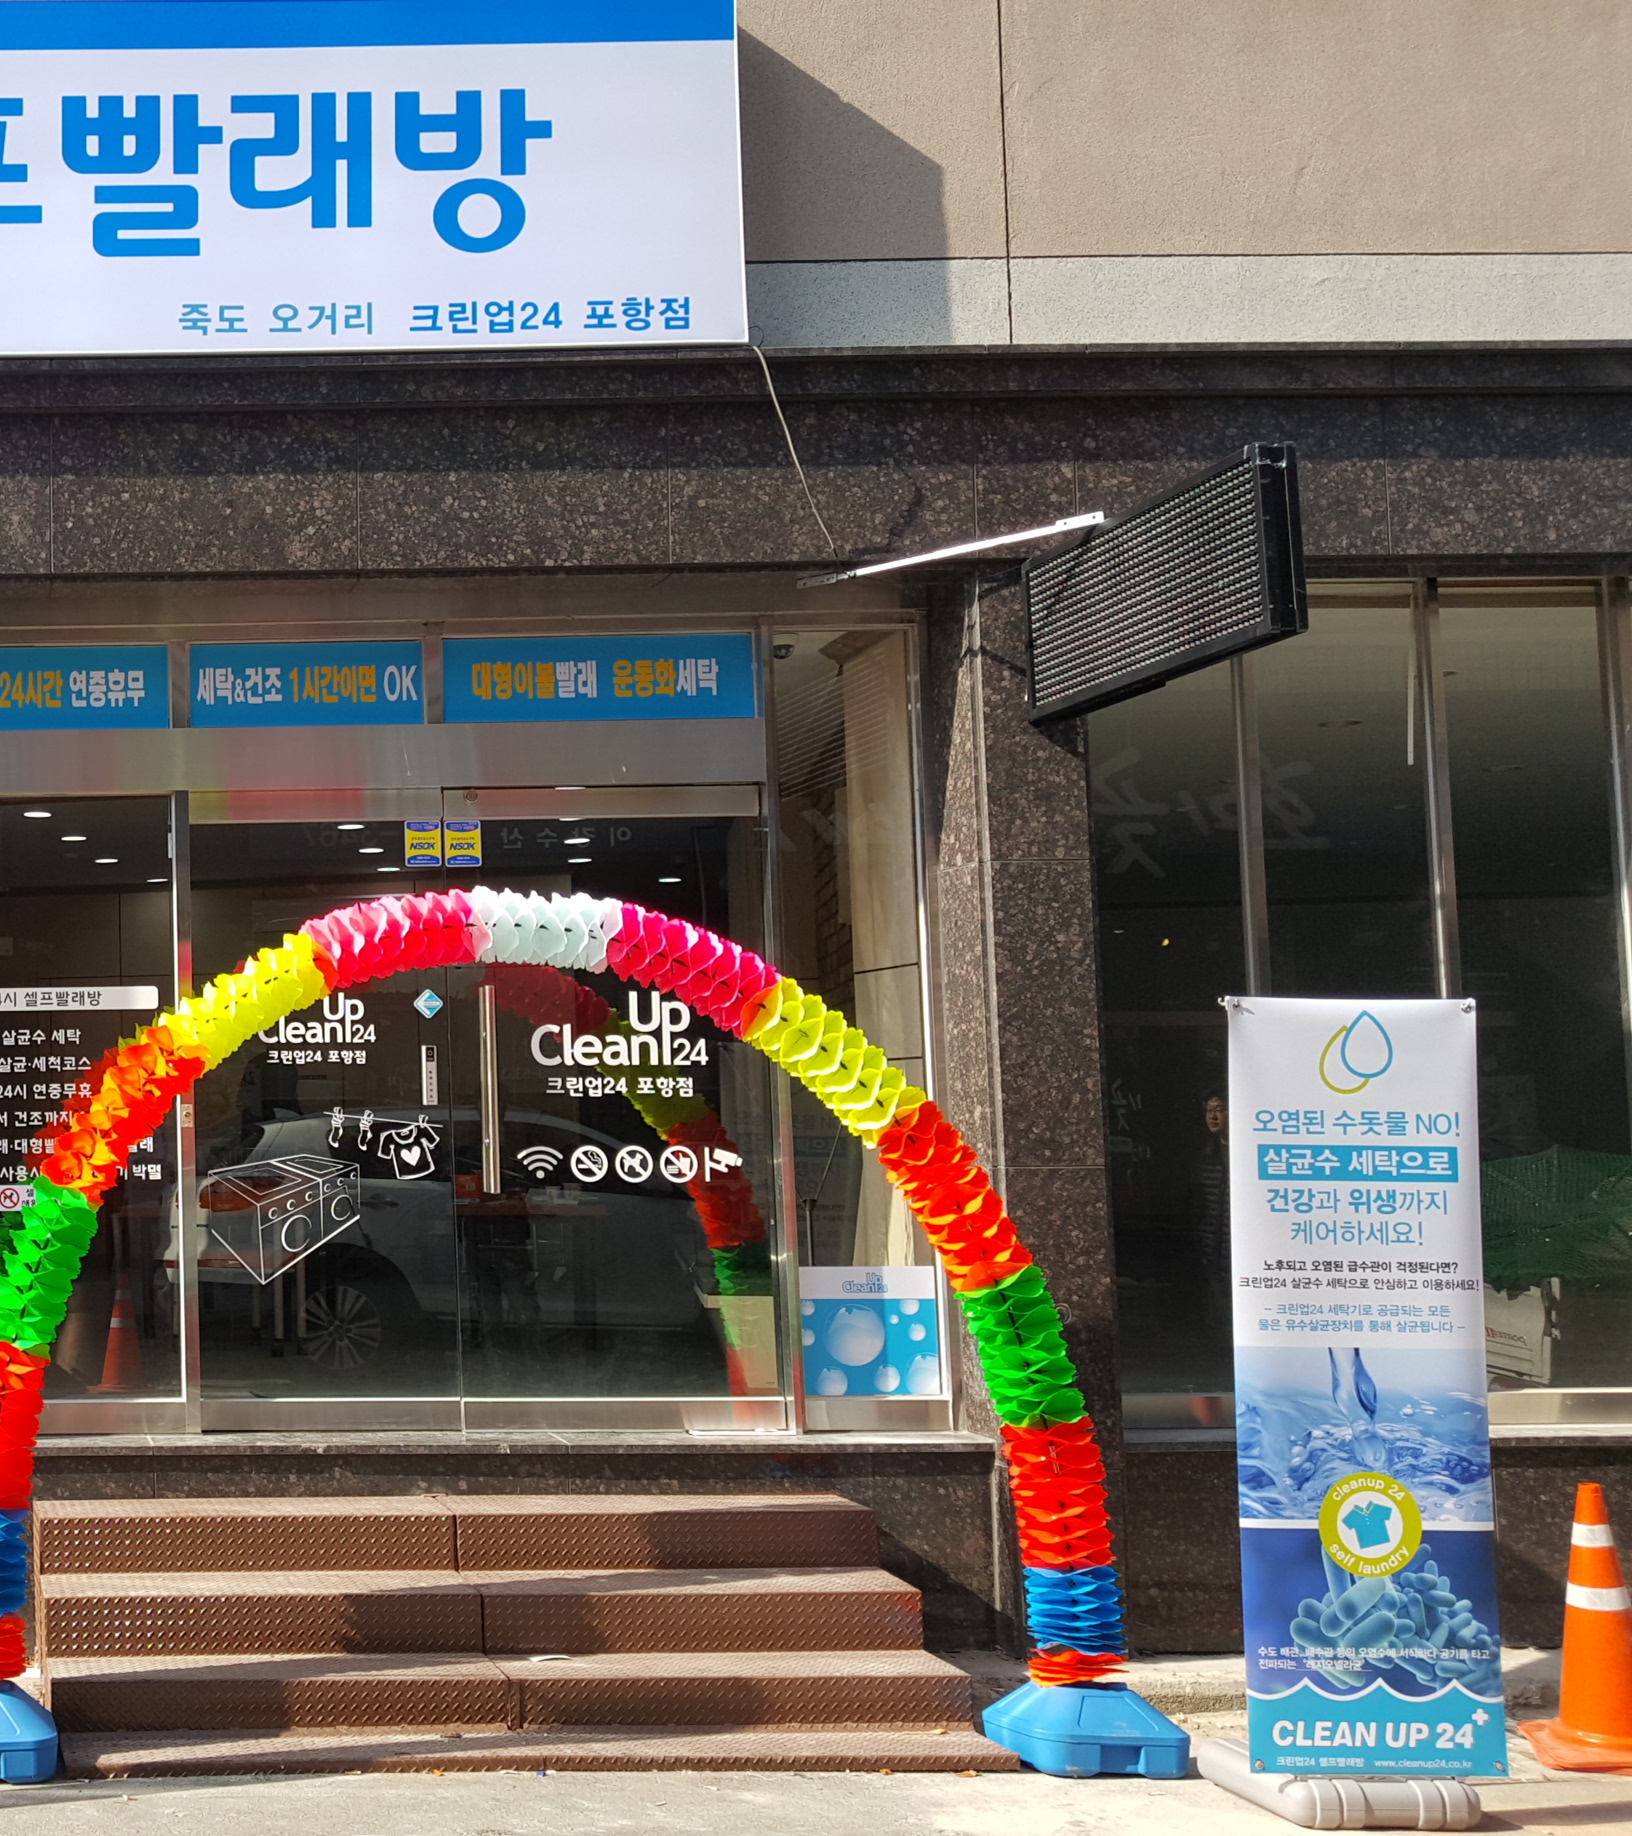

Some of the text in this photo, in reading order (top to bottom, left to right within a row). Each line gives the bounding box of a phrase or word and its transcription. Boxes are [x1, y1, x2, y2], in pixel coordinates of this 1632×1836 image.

[178, 302, 375, 335] 죽도 오거리
[409, 296, 692, 335] 크린업24 포항점
[197, 662, 417, 705] 세탁&건조 1시간이면 OK
[473, 656, 718, 700] 대형이불빨래 운동화세탁
[69, 667, 145, 709] 연중휴무
[409, 842, 436, 851] NSOK
[449, 842, 476, 851] NSOK
[24, 990, 102, 1007] 셀프빨래방
[2, 1029, 46, 1046] 살균수
[51, 1028, 81, 1045] 세탁
[353, 1026, 376, 1043] 24
[267, 1049, 366, 1065] 크린업24 포항점
[673, 1039, 708, 1066] 24
[33, 1083, 92, 1099] 연중무휴
[547, 1076, 693, 1097] 크린업24 포항점
[15, 1111, 72, 1127] 건조까지
[1252, 1110, 1460, 1137] 오염된 수돗물 NO!
[1263, 1148, 1453, 1176] 살균수 세탁으로
[133, 1164, 162, 1181] 박멸
[1266, 1188, 1448, 1215] 건강과 위생까지
[1291, 1220, 1424, 1247] 케어하세요!
[1263, 1259, 1458, 1274] 노후되고 오염된 급수관이 걱정된다면?
[1239, 1277, 1480, 1291] 크린업24 살균수 세탁으로 안심하고 이용하세요!
[1277, 1304, 1451, 1318] 크린업24 세탁기로 공급되는 모든
[1258, 1319, 1454, 1333] 물은 유수살균장치를 통해 살균됩니다
[1332, 1478, 1406, 1502] cleanup 24
[1329, 1543, 1411, 1575] self laundry
[1272, 1720, 1377, 1747] CLEAN
[1385, 1721, 1430, 1748] UP
[1374, 1758, 1472, 1769] www.cleanup24.co.kr
